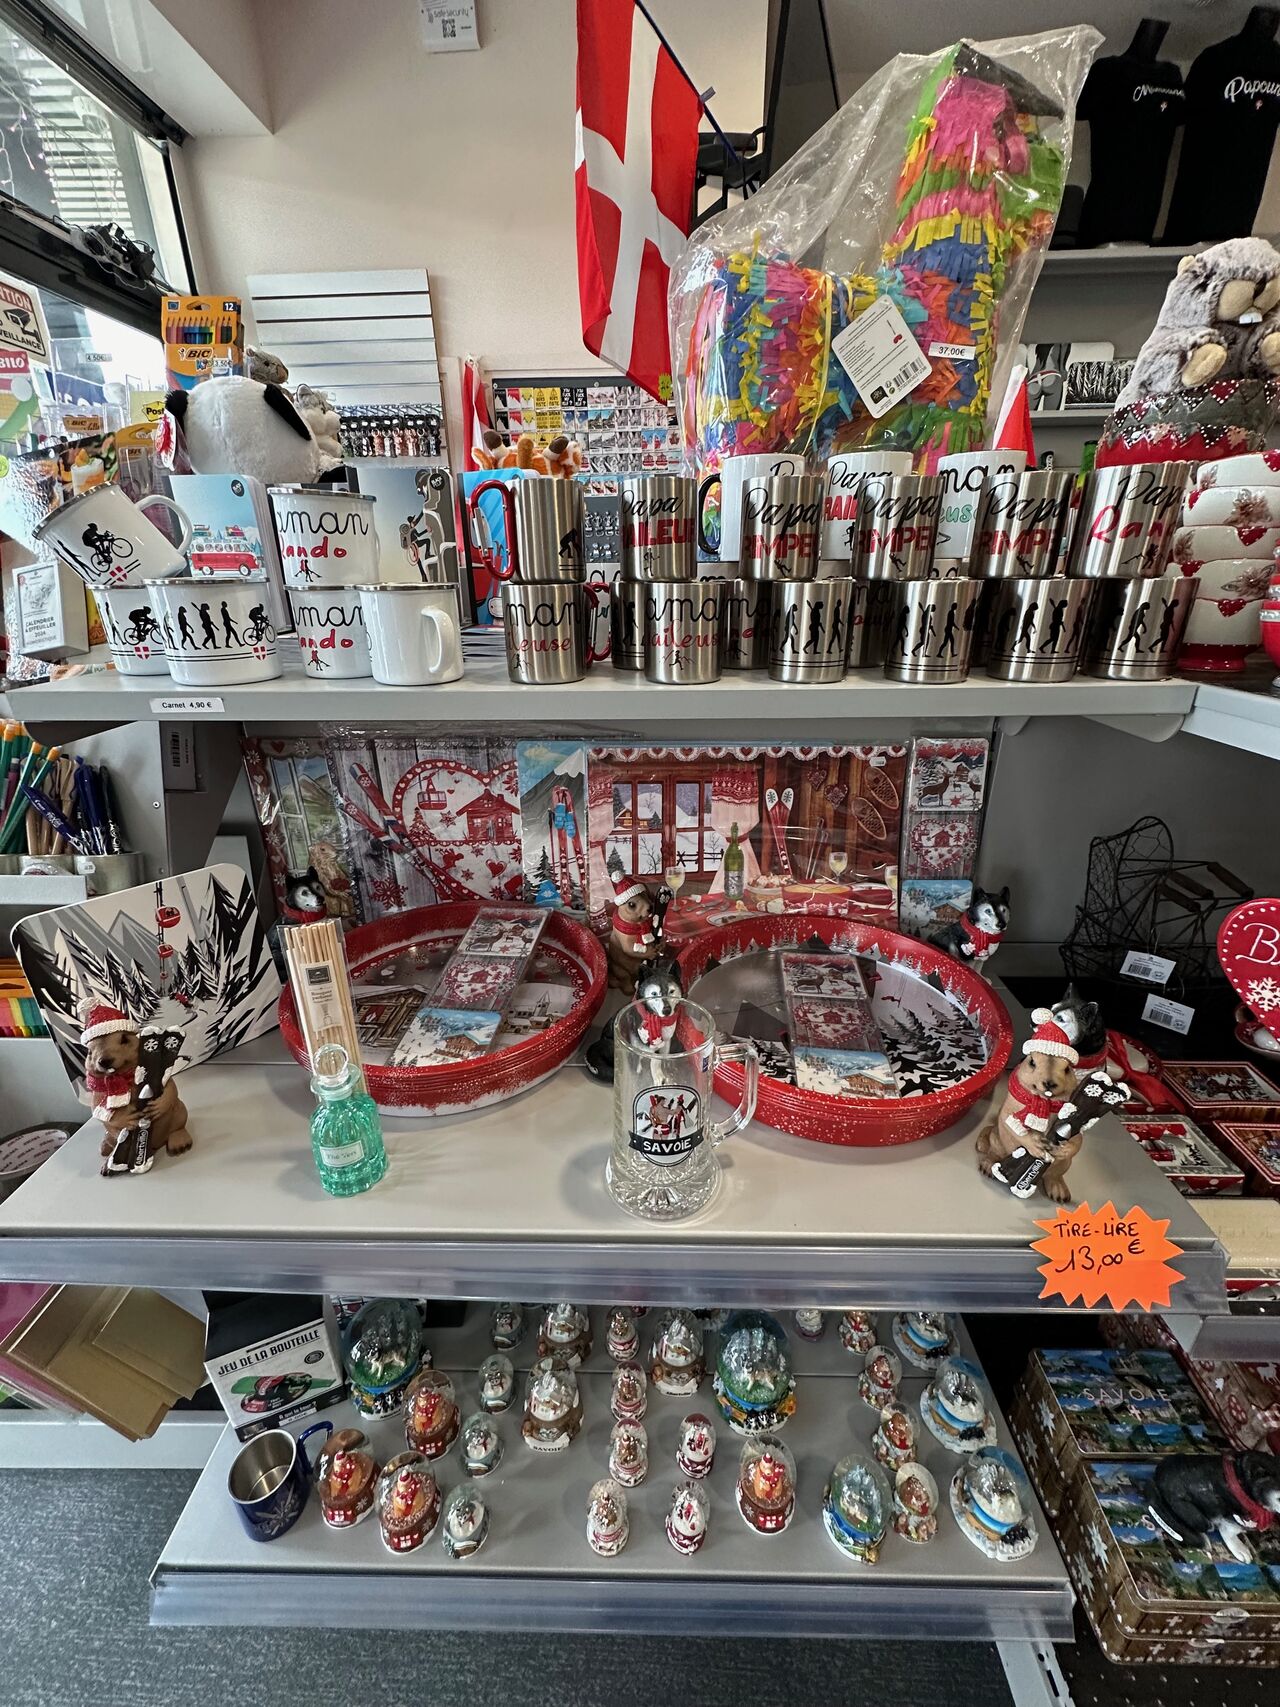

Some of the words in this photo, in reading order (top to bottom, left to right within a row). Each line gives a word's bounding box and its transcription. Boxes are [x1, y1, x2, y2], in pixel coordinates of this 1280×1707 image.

[224, 303, 234, 312] 12
[187, 350, 210, 359] BIC
[937, 346, 980, 357] 37,00€
[189, 701, 205, 709] 4,90
[1128, 1238, 1146, 1255] €
[218, 1361, 238, 1376] JEU
[239, 1355, 254, 1368] DE
[254, 1349, 269, 1362] LA
[269, 1329, 320, 1356] BOUTEILLE
[1081, 1388, 1172, 1403] SAVOIE
